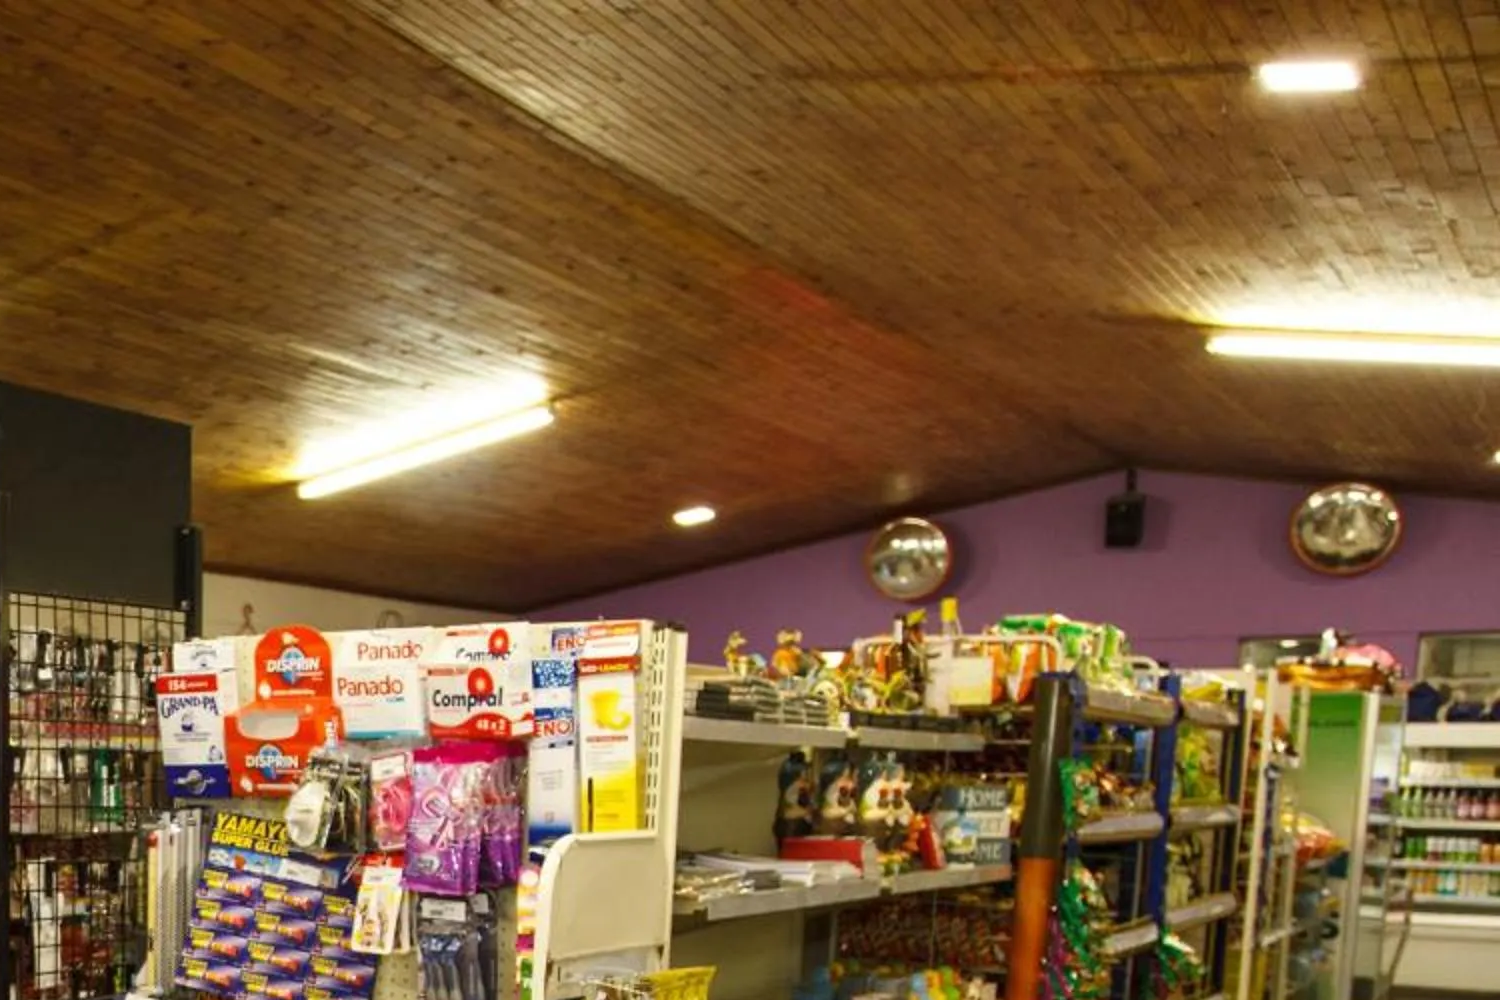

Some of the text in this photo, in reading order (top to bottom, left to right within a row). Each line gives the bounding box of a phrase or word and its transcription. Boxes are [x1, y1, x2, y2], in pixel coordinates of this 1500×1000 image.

[357, 640, 423, 660] Panado
[266, 657, 321, 672] DISPRIN
[337, 675, 404, 696] Panado
[432, 688, 503, 712] Compral
[535, 719, 574, 737] ENO
[245, 755, 299, 769] DISPRIN
[212, 829, 253, 849] SUPER
